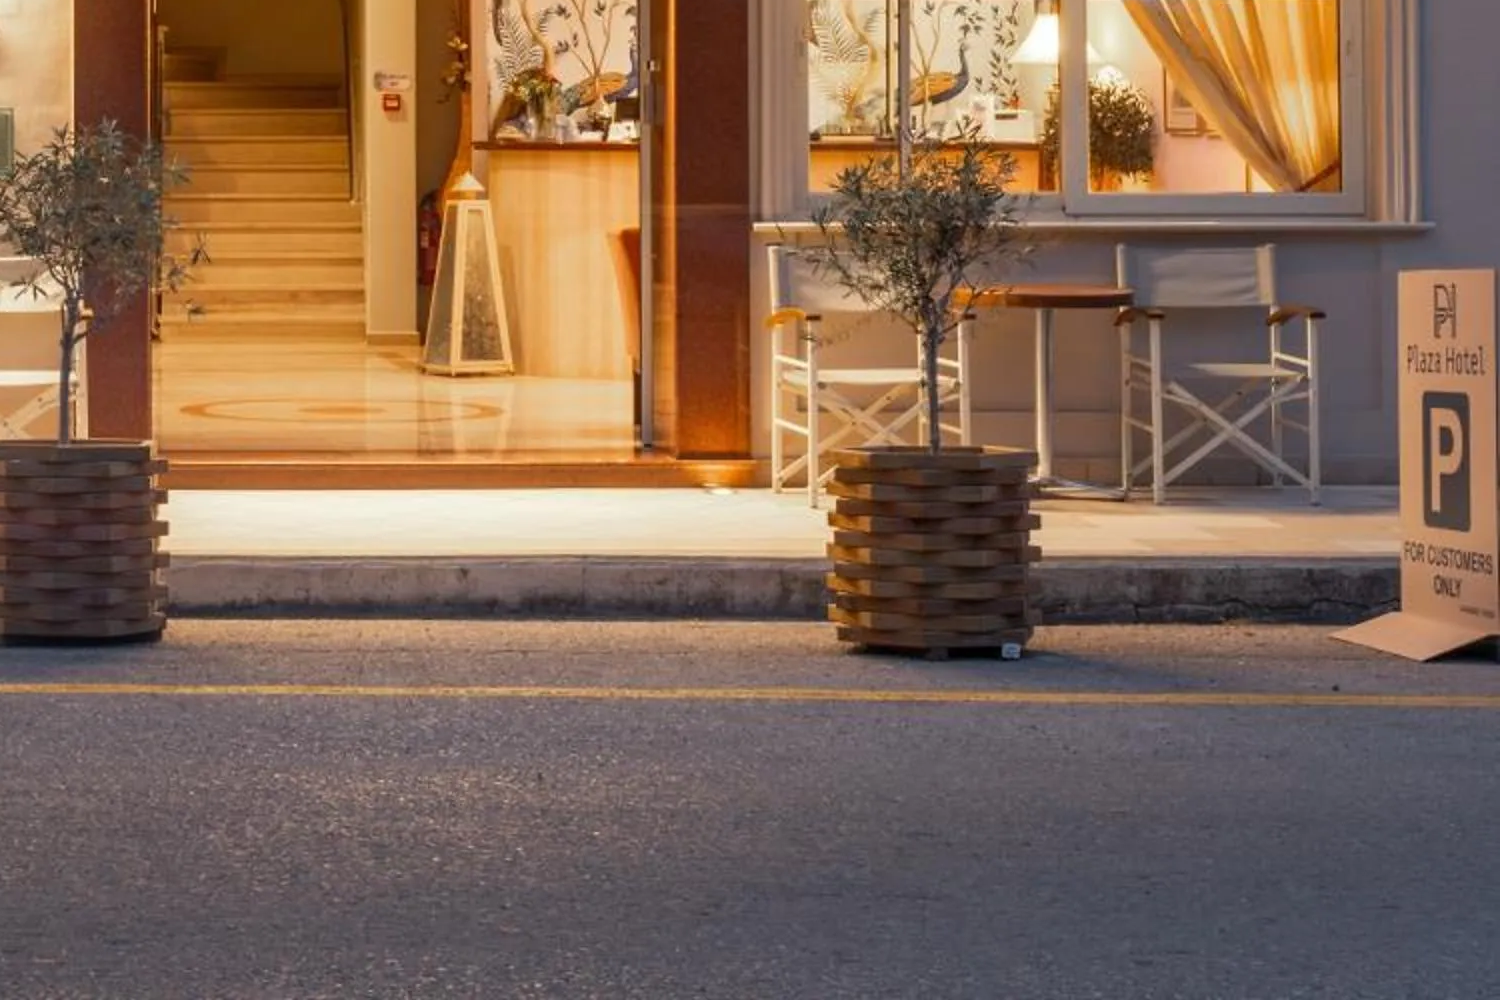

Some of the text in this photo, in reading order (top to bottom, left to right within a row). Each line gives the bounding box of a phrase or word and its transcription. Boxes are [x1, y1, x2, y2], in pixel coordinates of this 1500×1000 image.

[1407, 343, 1486, 376] Plaza Hotel
[1429, 405, 1463, 514] P
[1404, 541, 1493, 576] FOR CUSTOMERS
[1433, 574, 1462, 599] ONLY
